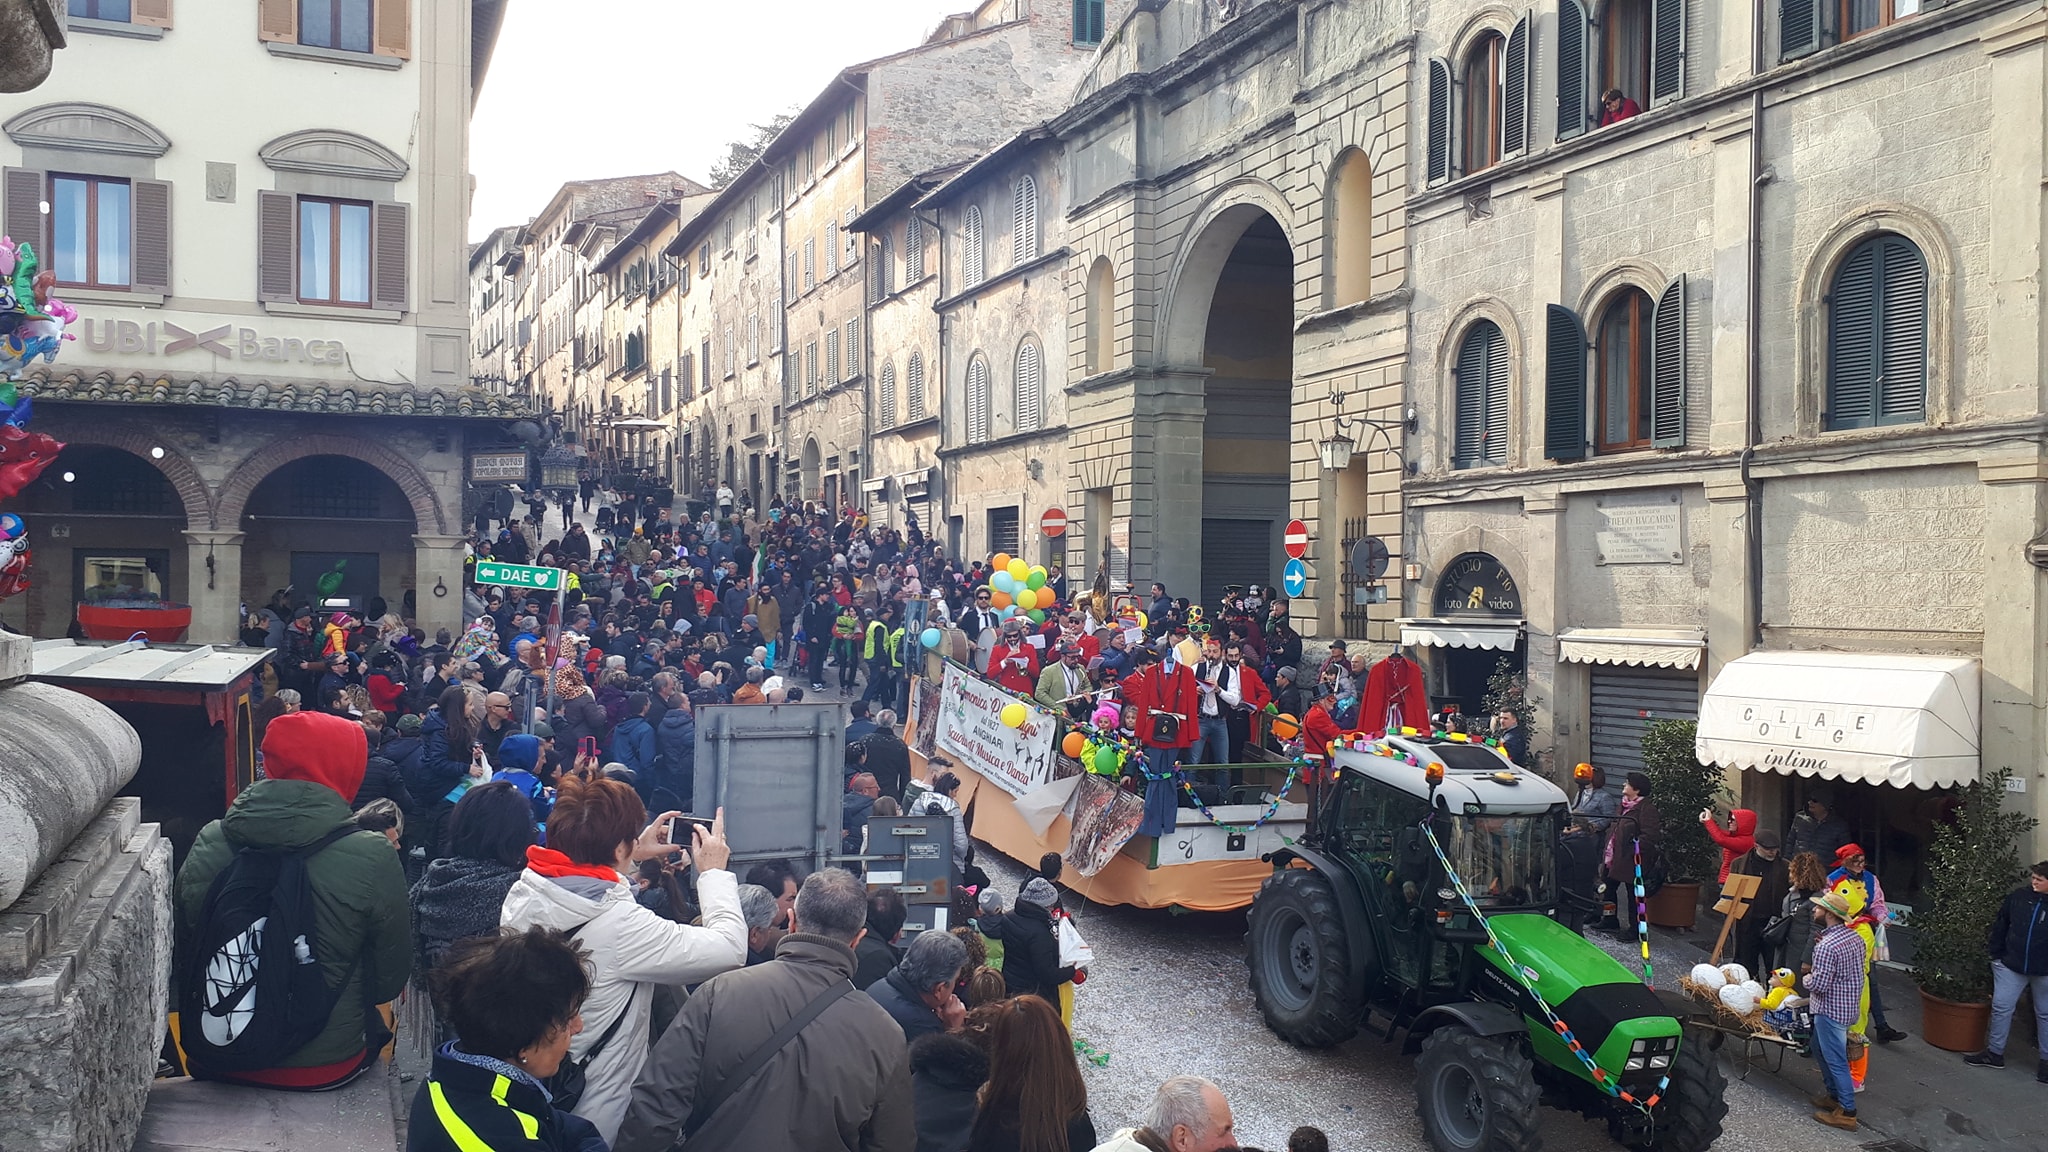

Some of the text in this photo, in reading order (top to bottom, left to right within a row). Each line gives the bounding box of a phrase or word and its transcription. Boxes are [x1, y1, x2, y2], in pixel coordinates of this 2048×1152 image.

[84, 318, 344, 364] UBI Banca
[1635, 513, 1676, 525] BACCARINI
[501, 568, 531, 583] DAE
[1445, 558, 1482, 592] STUDIO
[1444, 596, 1514, 610] foto video
[972, 725, 1004, 751] ANGHIARI
[975, 742, 1000, 770] Musica
[1006, 760, 1030, 786] Danza
[1764, 748, 1828, 770] intimo
[2009, 779, 2021, 789] 87
[1485, 968, 1520, 997] DEUTZ-FAHR
